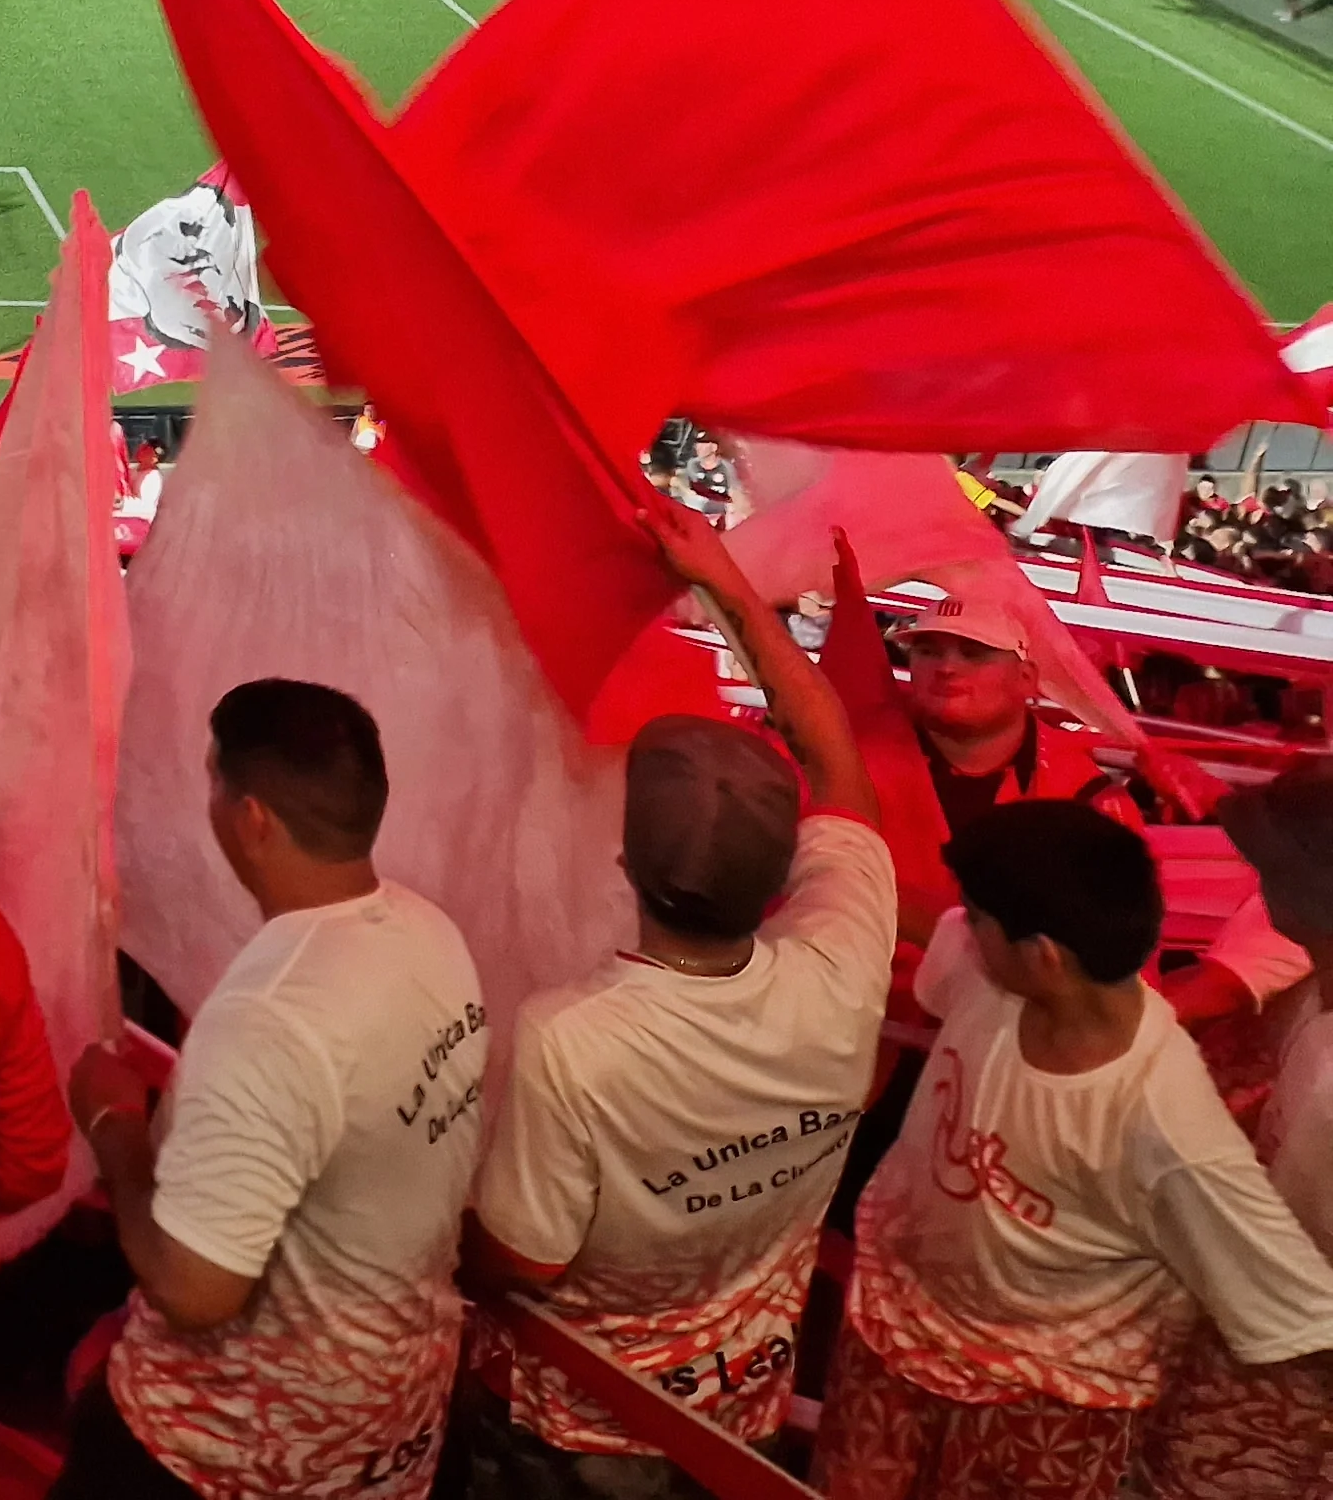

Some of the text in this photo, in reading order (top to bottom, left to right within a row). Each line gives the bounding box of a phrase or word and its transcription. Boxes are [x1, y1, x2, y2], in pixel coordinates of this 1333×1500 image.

[642, 1170, 688, 1196] La
[692, 1124, 789, 1172] Unica
[686, 1193, 723, 1214] De
[730, 1181, 764, 1202] La
